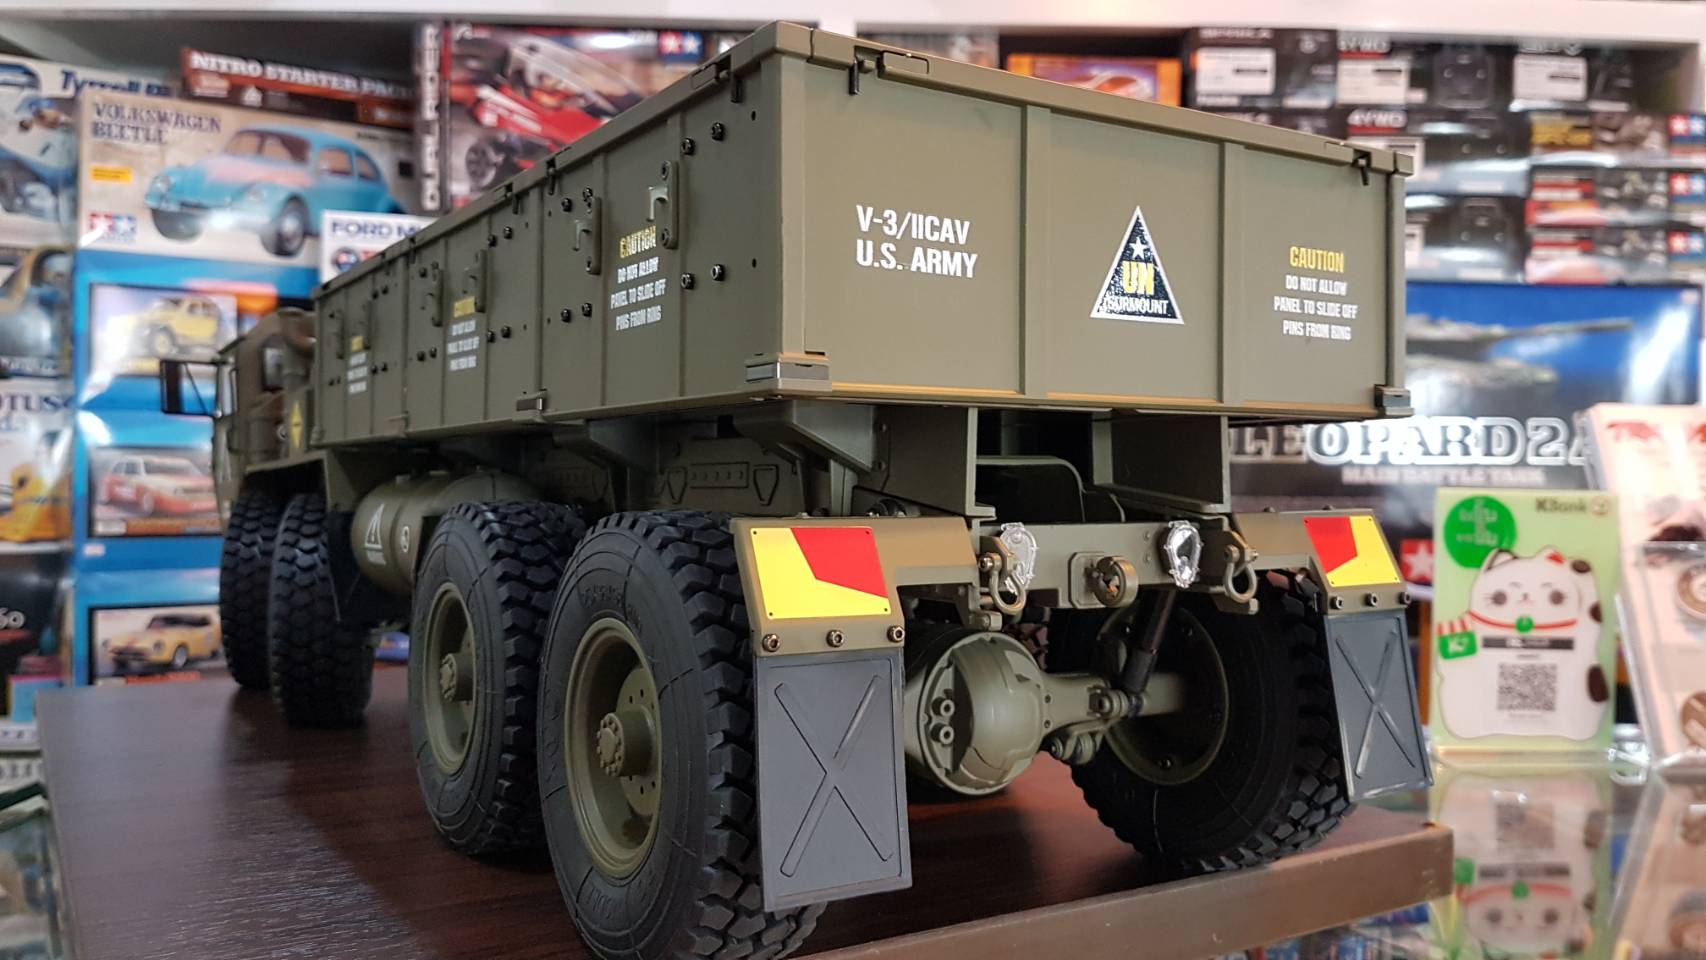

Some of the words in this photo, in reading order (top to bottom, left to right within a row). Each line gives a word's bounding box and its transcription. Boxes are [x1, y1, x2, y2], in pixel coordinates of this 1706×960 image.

[190, 50, 263, 78] NITRO
[264, 62, 357, 93] STARTER
[94, 103, 221, 133] VOLKSWAGEN
[92, 122, 168, 145] BEETLE
[856, 204, 970, 245] V-3/IICAV
[619, 225, 657, 259] CAUTION
[856, 238, 903, 270] U.S.
[910, 246, 978, 279] ARMY
[1289, 246, 1345, 273] CAUTION
[1121, 260, 1155, 296] UN
[1285, 274, 1299, 290] DO
[1299, 276, 1318, 293] NOT
[1318, 279, 1348, 296] ALLOW
[1273, 296, 1302, 313] PANEL
[1303, 299, 1315, 315] TO
[1316, 301, 1341, 318] SLIDE
[1341, 304, 1358, 319] OFF
[1282, 320, 1304, 336] PINS
[1305, 321, 1330, 338] FROM
